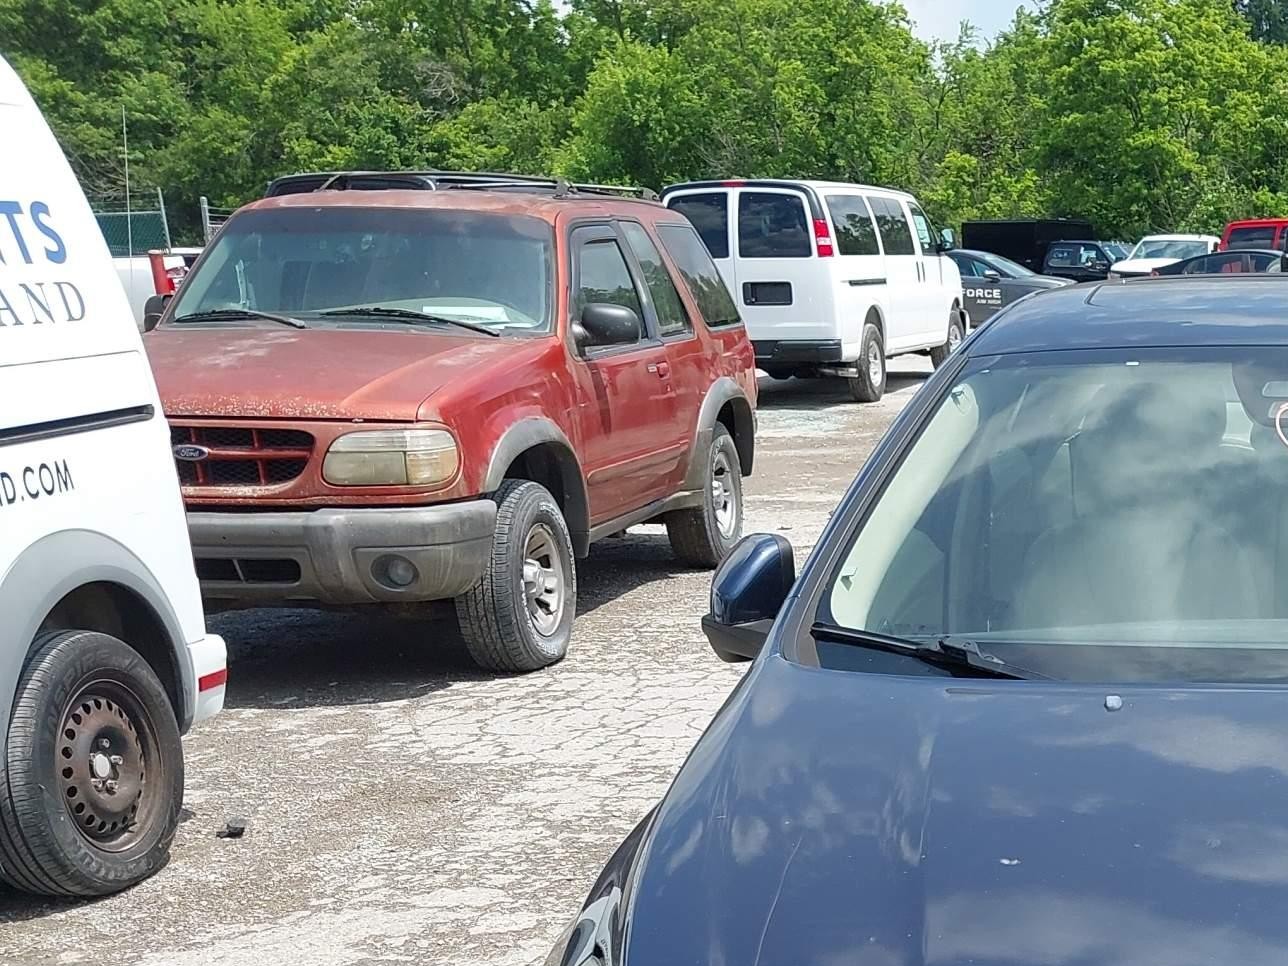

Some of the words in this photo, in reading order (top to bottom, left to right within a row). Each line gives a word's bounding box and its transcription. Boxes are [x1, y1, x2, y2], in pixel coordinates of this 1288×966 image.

[0, 200, 67, 266] TS
[961, 288, 1001, 298] FORCE
[0, 458, 75, 506] D.COM
